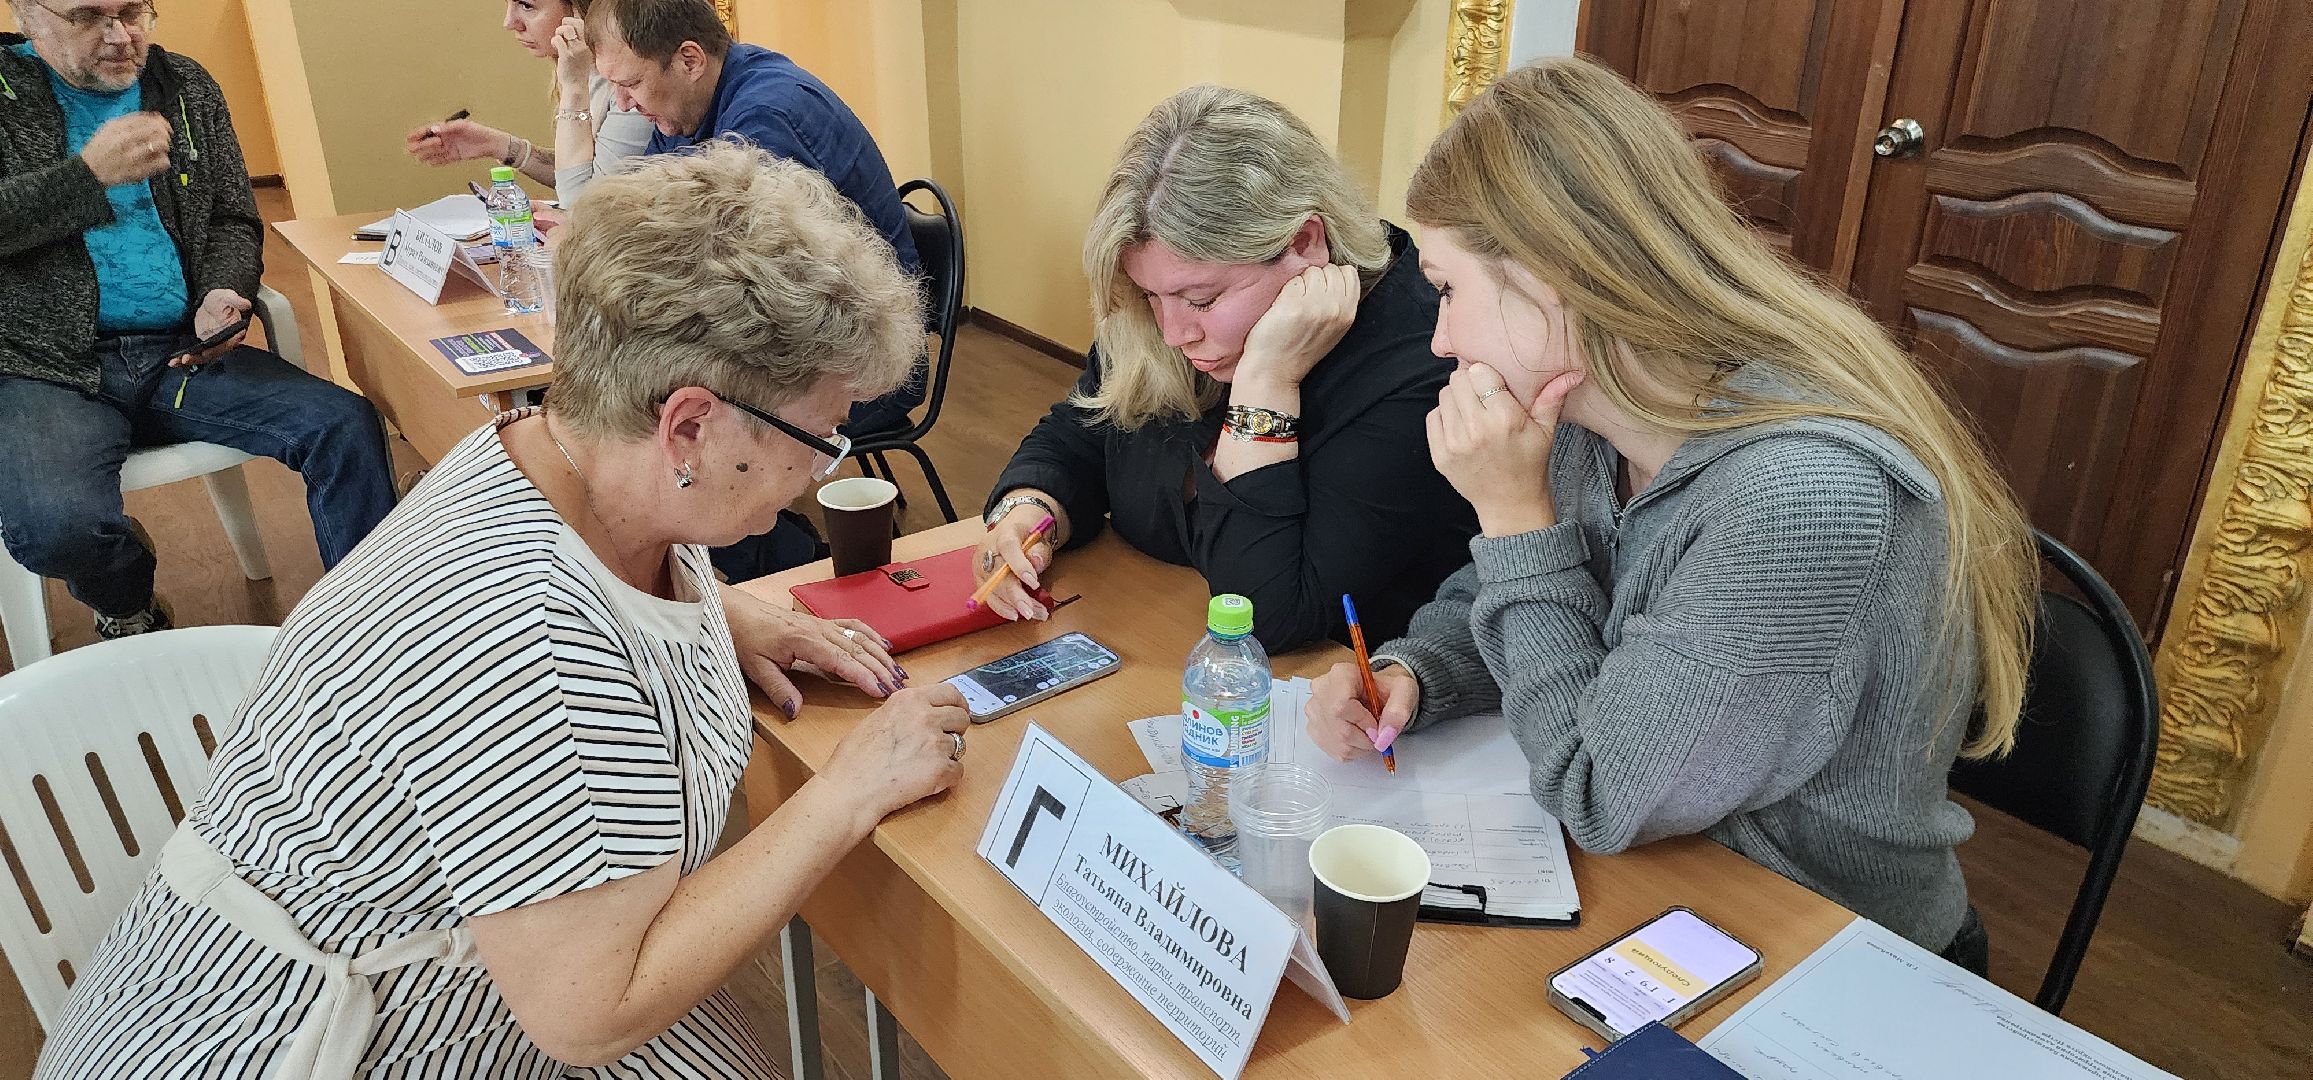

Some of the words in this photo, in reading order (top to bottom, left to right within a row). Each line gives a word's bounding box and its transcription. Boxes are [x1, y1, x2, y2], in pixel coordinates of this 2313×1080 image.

[384, 230, 402, 266] В
[1005, 784, 1067, 870] Г
[1073, 853, 1132, 917] Татьяна
[1138, 904, 1252, 1021] Владимировна
[1100, 832, 1248, 974] МИХАЙЛОВА
[1051, 899, 1095, 945] экология,
[1096, 936, 1158, 997] содержание
[1158, 983, 1228, 1060] территорий
[1141, 942, 1174, 988] парки,
[1175, 977, 1240, 1048] транспорт,
[1631, 948, 1691, 987] Следующий
